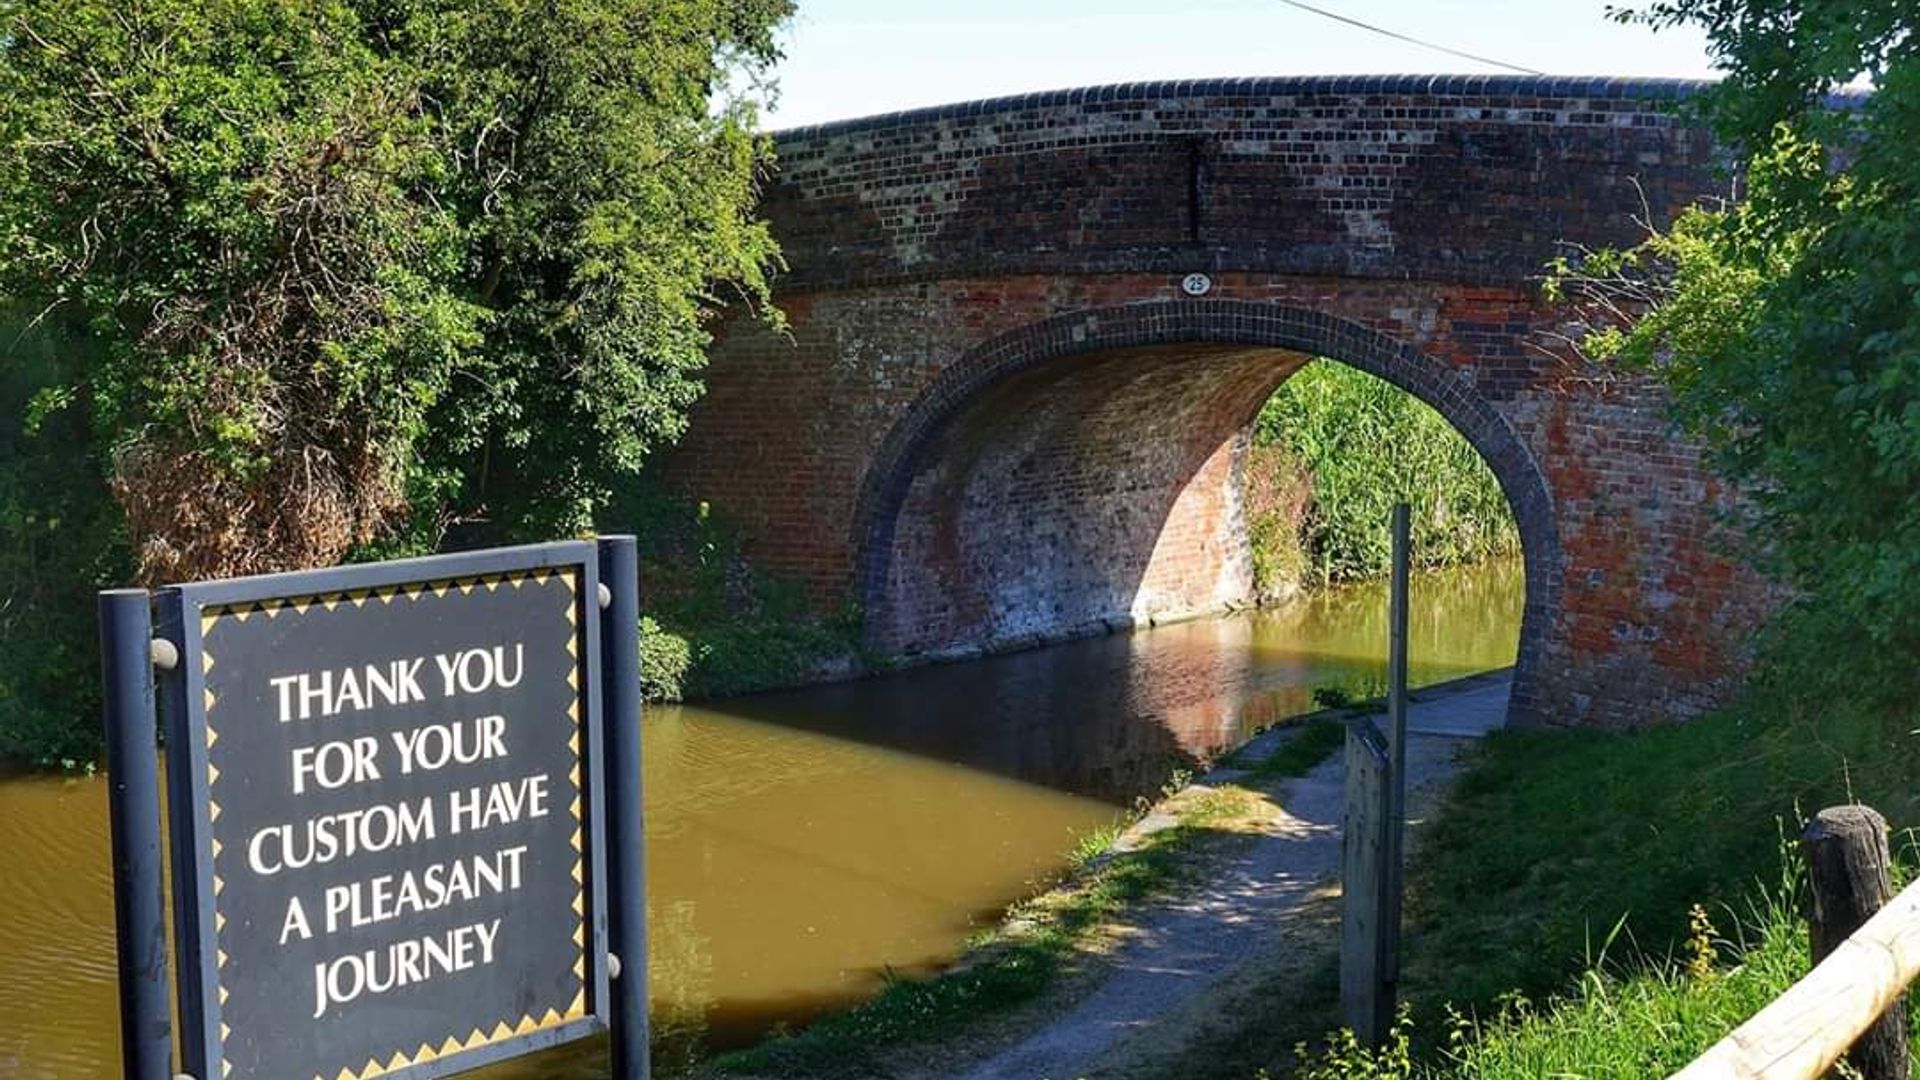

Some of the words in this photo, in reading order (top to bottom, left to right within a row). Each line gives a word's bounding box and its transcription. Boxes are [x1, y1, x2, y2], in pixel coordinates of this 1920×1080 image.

[1189, 276, 1204, 291] 25
[270, 657, 426, 722] THANK
[434, 644, 523, 697] YOU
[292, 737, 381, 794] FOR
[392, 715, 508, 774] YOUR
[249, 797, 436, 874] CUSTOM
[450, 775, 549, 834] HAVE
[279, 896, 313, 944] A
[326, 846, 528, 933] PLEASANT
[313, 919, 501, 1018] JOURNEY
